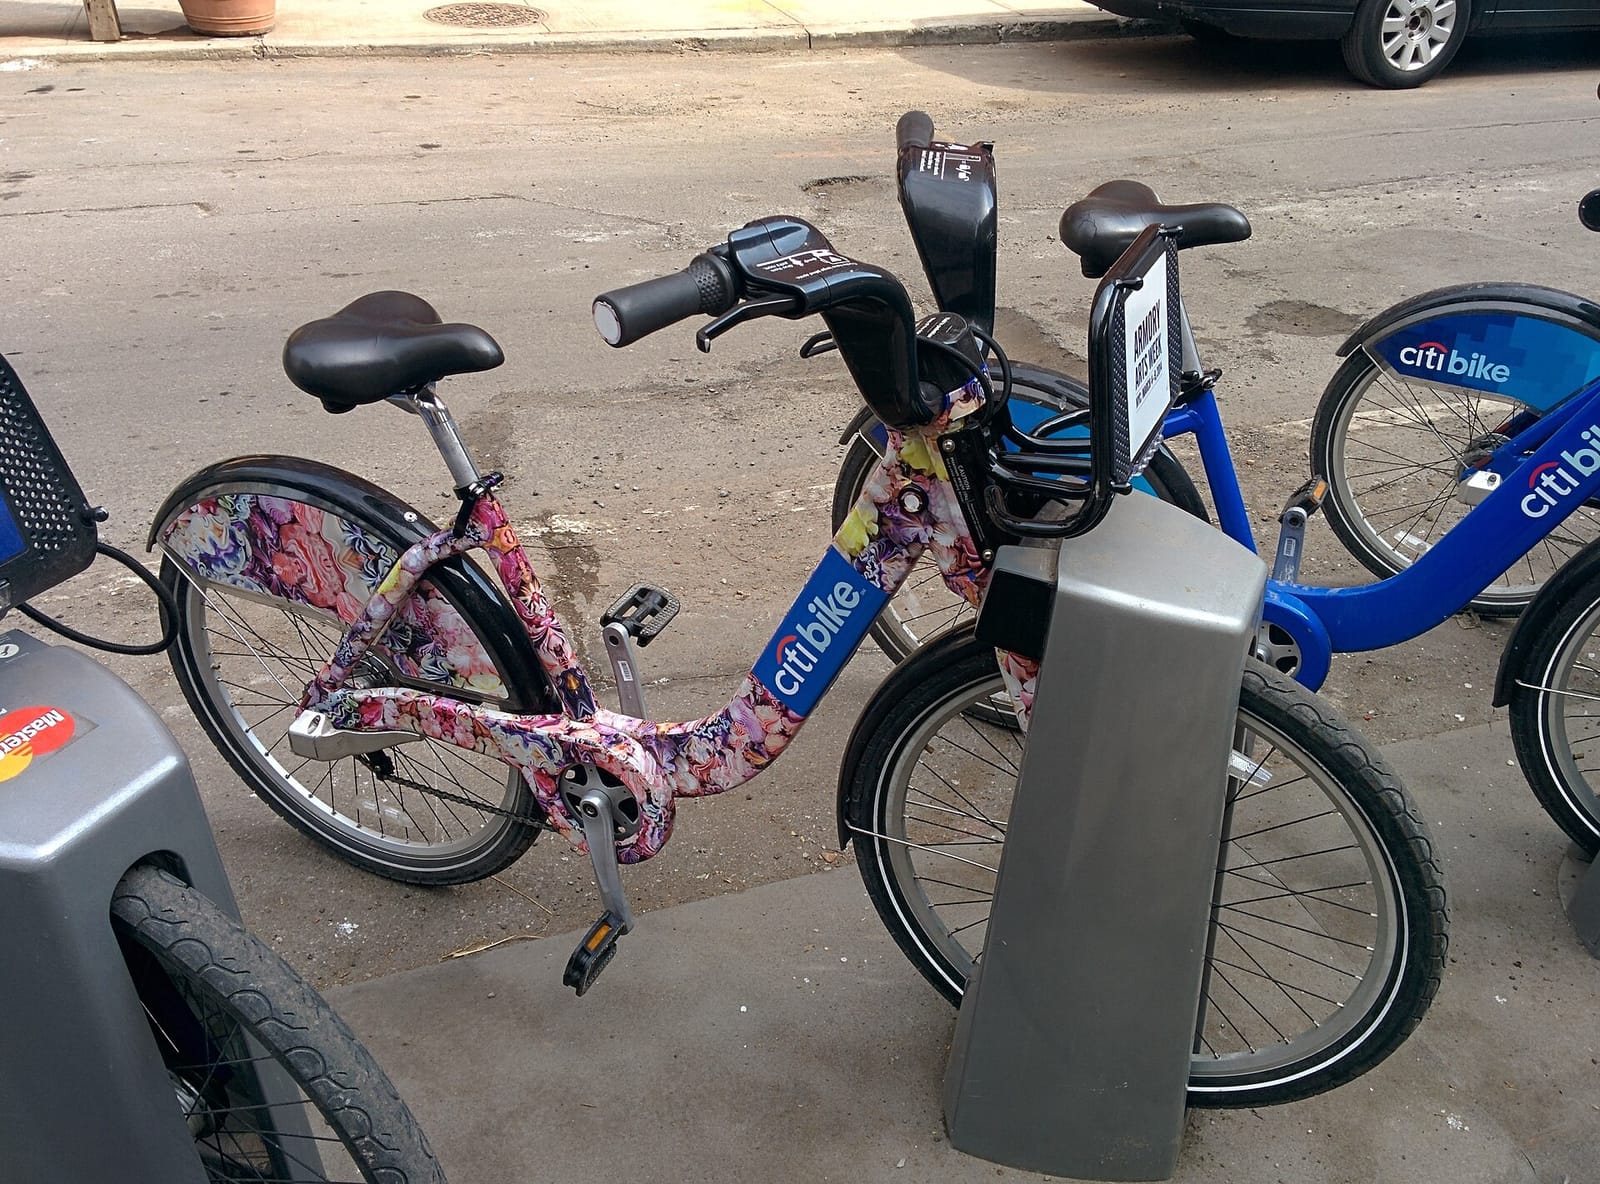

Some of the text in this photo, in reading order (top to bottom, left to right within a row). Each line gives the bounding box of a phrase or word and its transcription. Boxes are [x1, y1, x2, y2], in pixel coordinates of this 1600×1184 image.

[1134, 298, 1161, 363] ARMORY
[1135, 353, 1149, 391] ARTS
[1147, 332, 1163, 370] WEEK
[1400, 341, 1511, 383] citi bike
[957, 464, 971, 491] CAUTION
[1521, 424, 1600, 518] citi bi
[775, 581, 860, 696] citi bike
